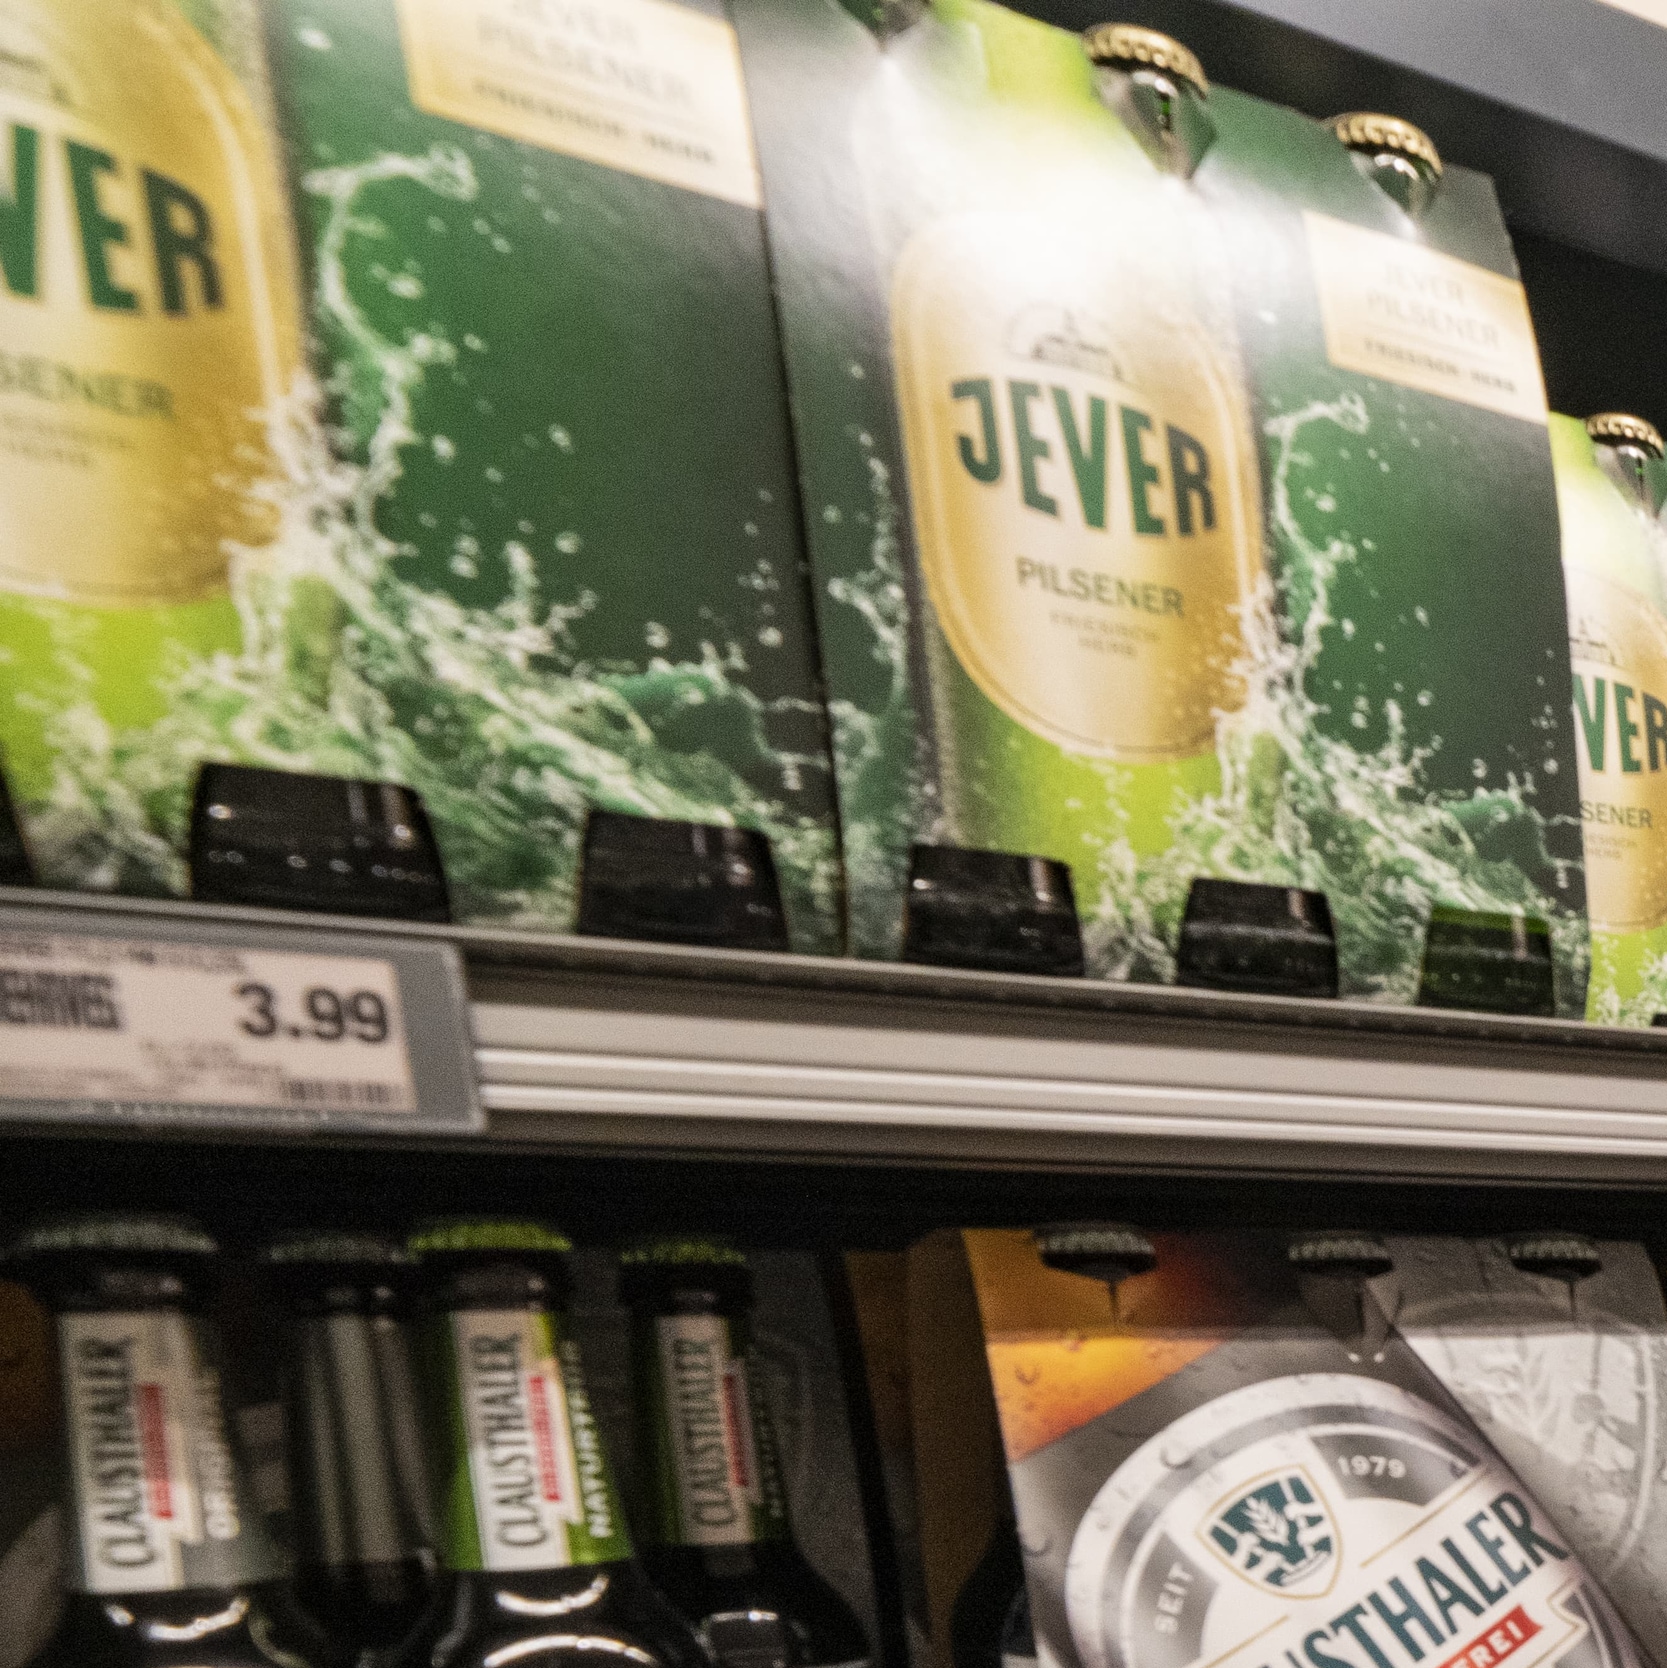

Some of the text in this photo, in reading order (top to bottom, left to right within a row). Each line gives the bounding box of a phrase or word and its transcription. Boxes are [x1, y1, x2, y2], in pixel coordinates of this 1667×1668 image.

[1366, 287, 1500, 351] PILSENER
[950, 378, 1218, 538] JEVER
[1016, 556, 1185, 620] PILSENER
[235, 982, 390, 1045] 3.99
[471, 1331, 550, 1550] CLAUSTHALER
[671, 1335, 738, 1530] CLAUSTHALER
[1337, 1451, 1408, 1481] 1979
[1153, 1558, 1194, 1634] SEIT
